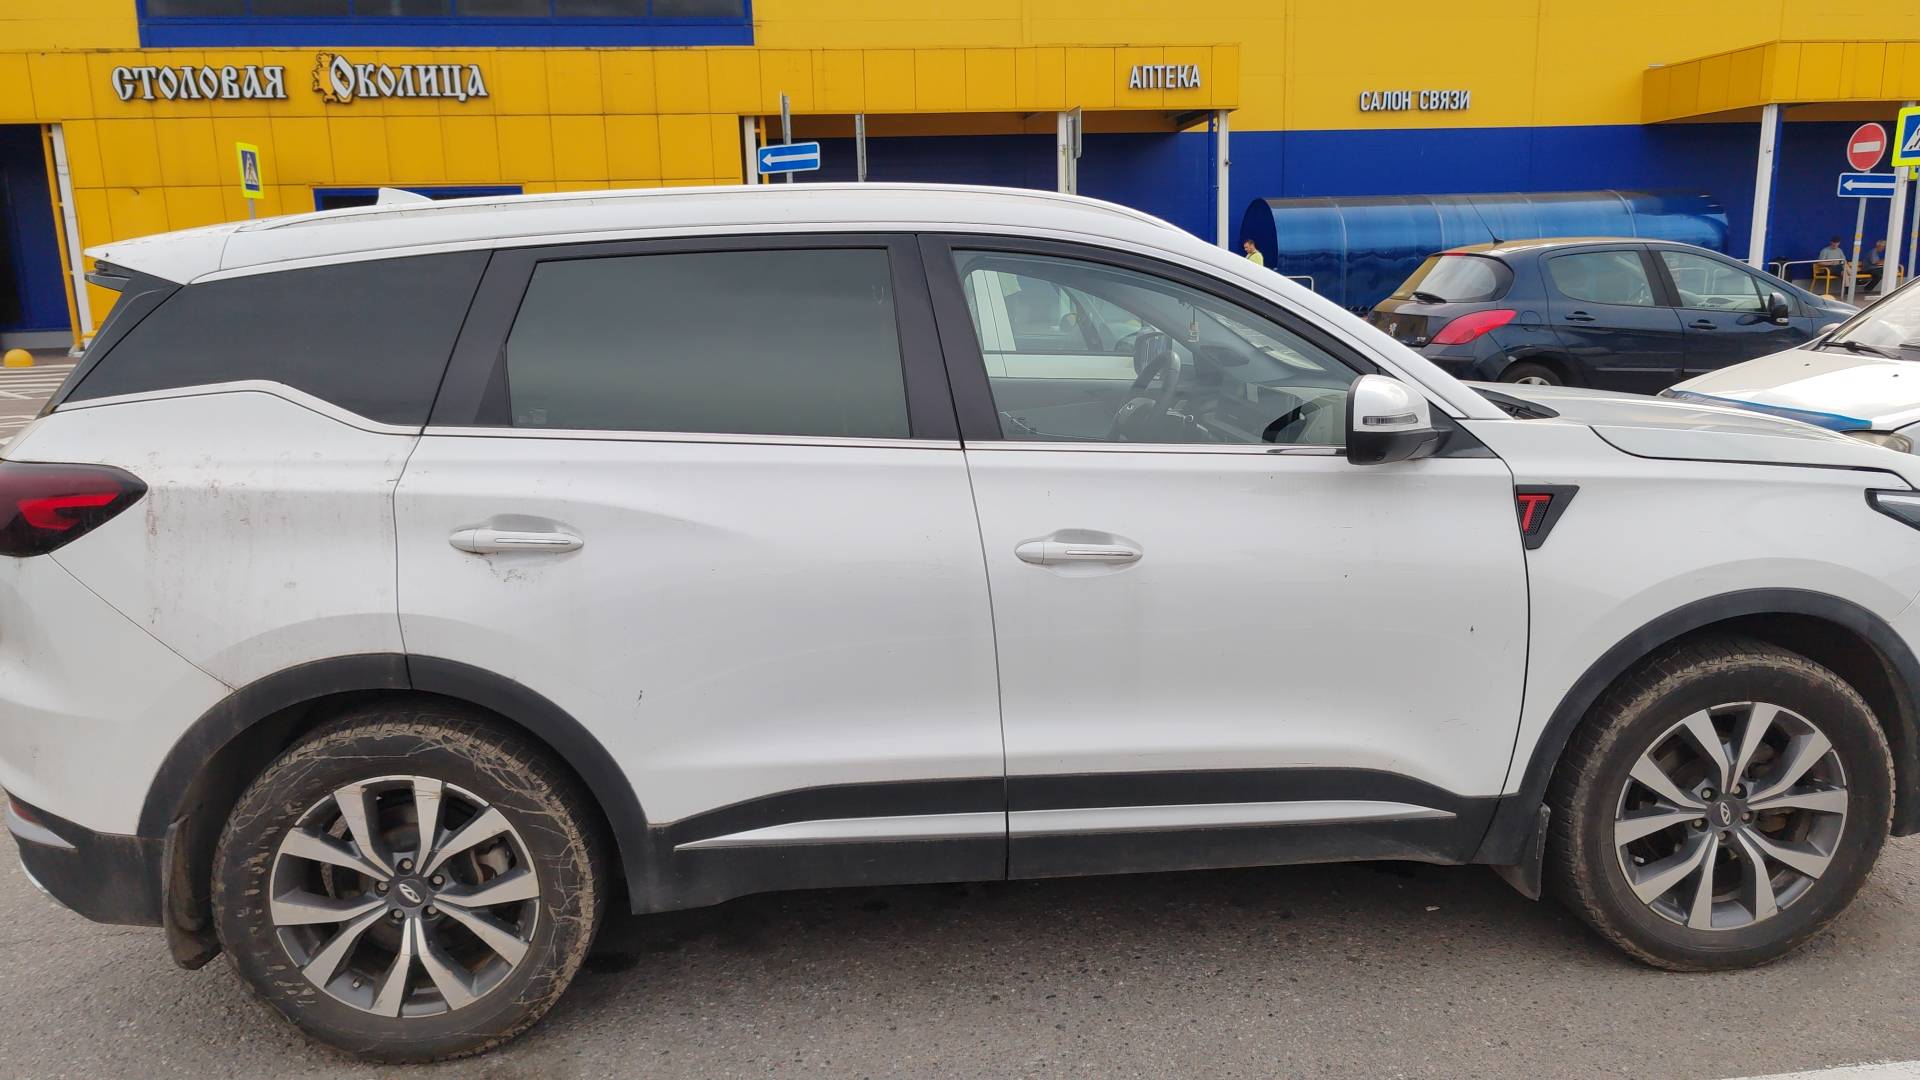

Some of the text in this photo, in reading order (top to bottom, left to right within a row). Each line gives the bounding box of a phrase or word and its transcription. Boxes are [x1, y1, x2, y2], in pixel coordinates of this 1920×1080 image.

[111, 65, 288, 101] СТОЛОВАЯ
[1129, 64, 1201, 89] АПТЕКА
[1360, 90, 1472, 112] САЛОН СВЯЗИ
